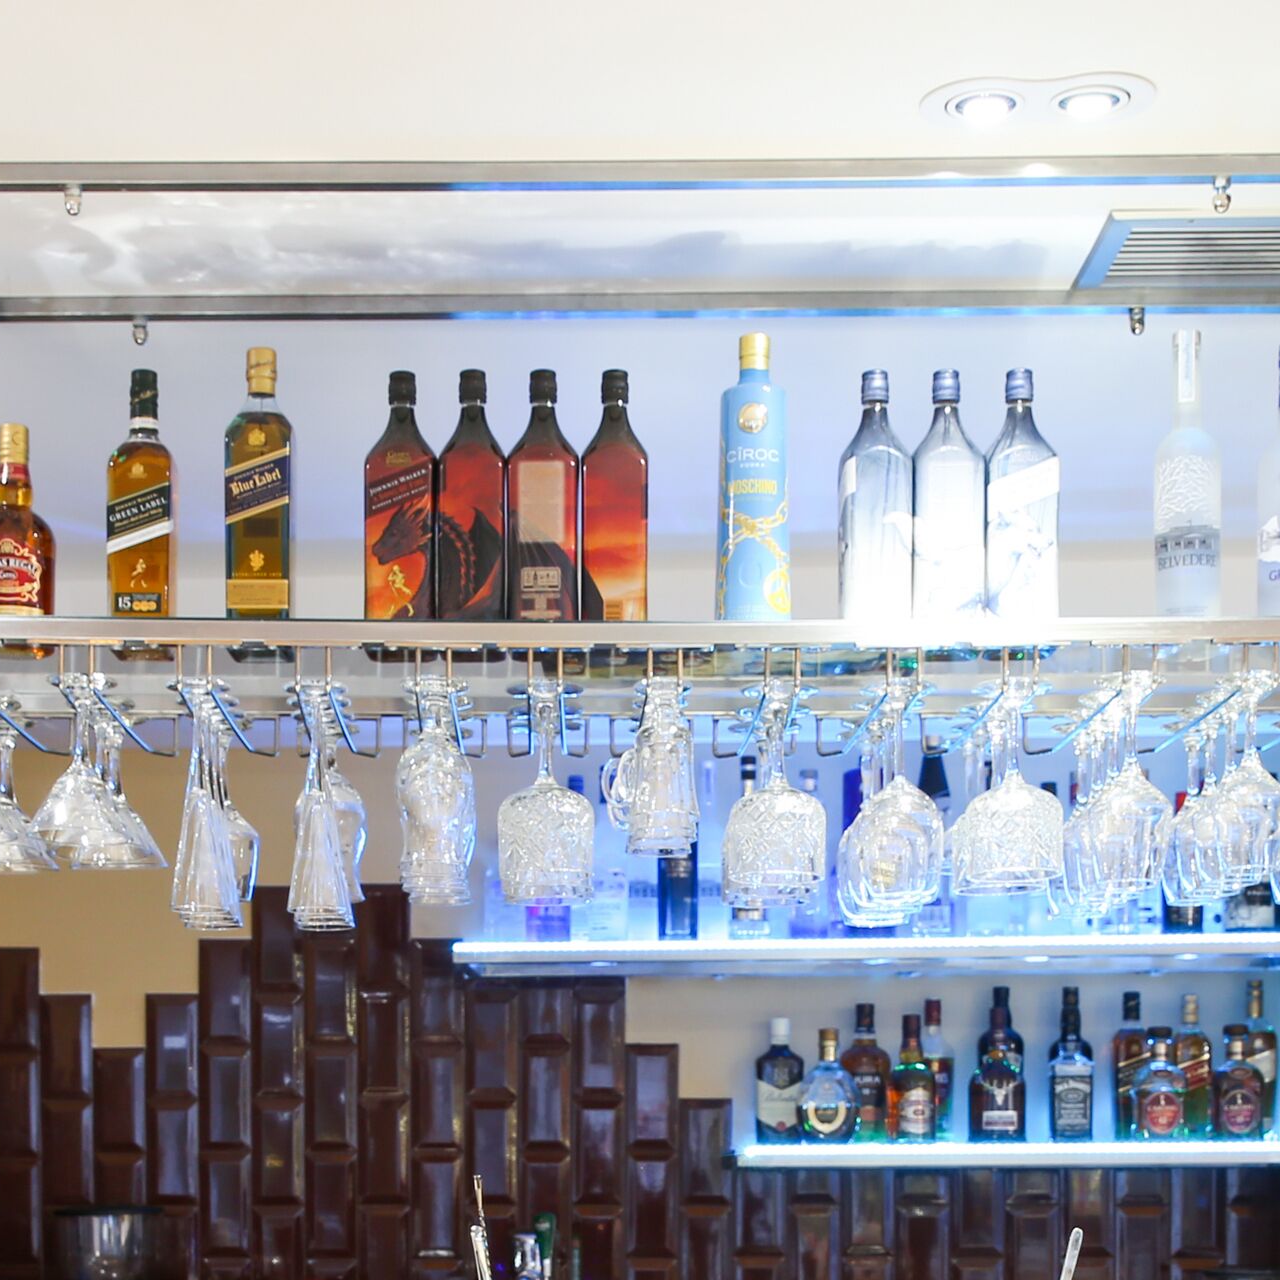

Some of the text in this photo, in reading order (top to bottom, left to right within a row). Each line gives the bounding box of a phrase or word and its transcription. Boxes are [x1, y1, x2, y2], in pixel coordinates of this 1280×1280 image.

[229, 480, 255, 497] Blue
[253, 468, 282, 487] Label
[109, 507, 138, 522] GREEN
[140, 497, 168, 511] LABEL
[1158, 553, 1217, 571] BELVEDERE
[118, 596, 132, 608] 15
